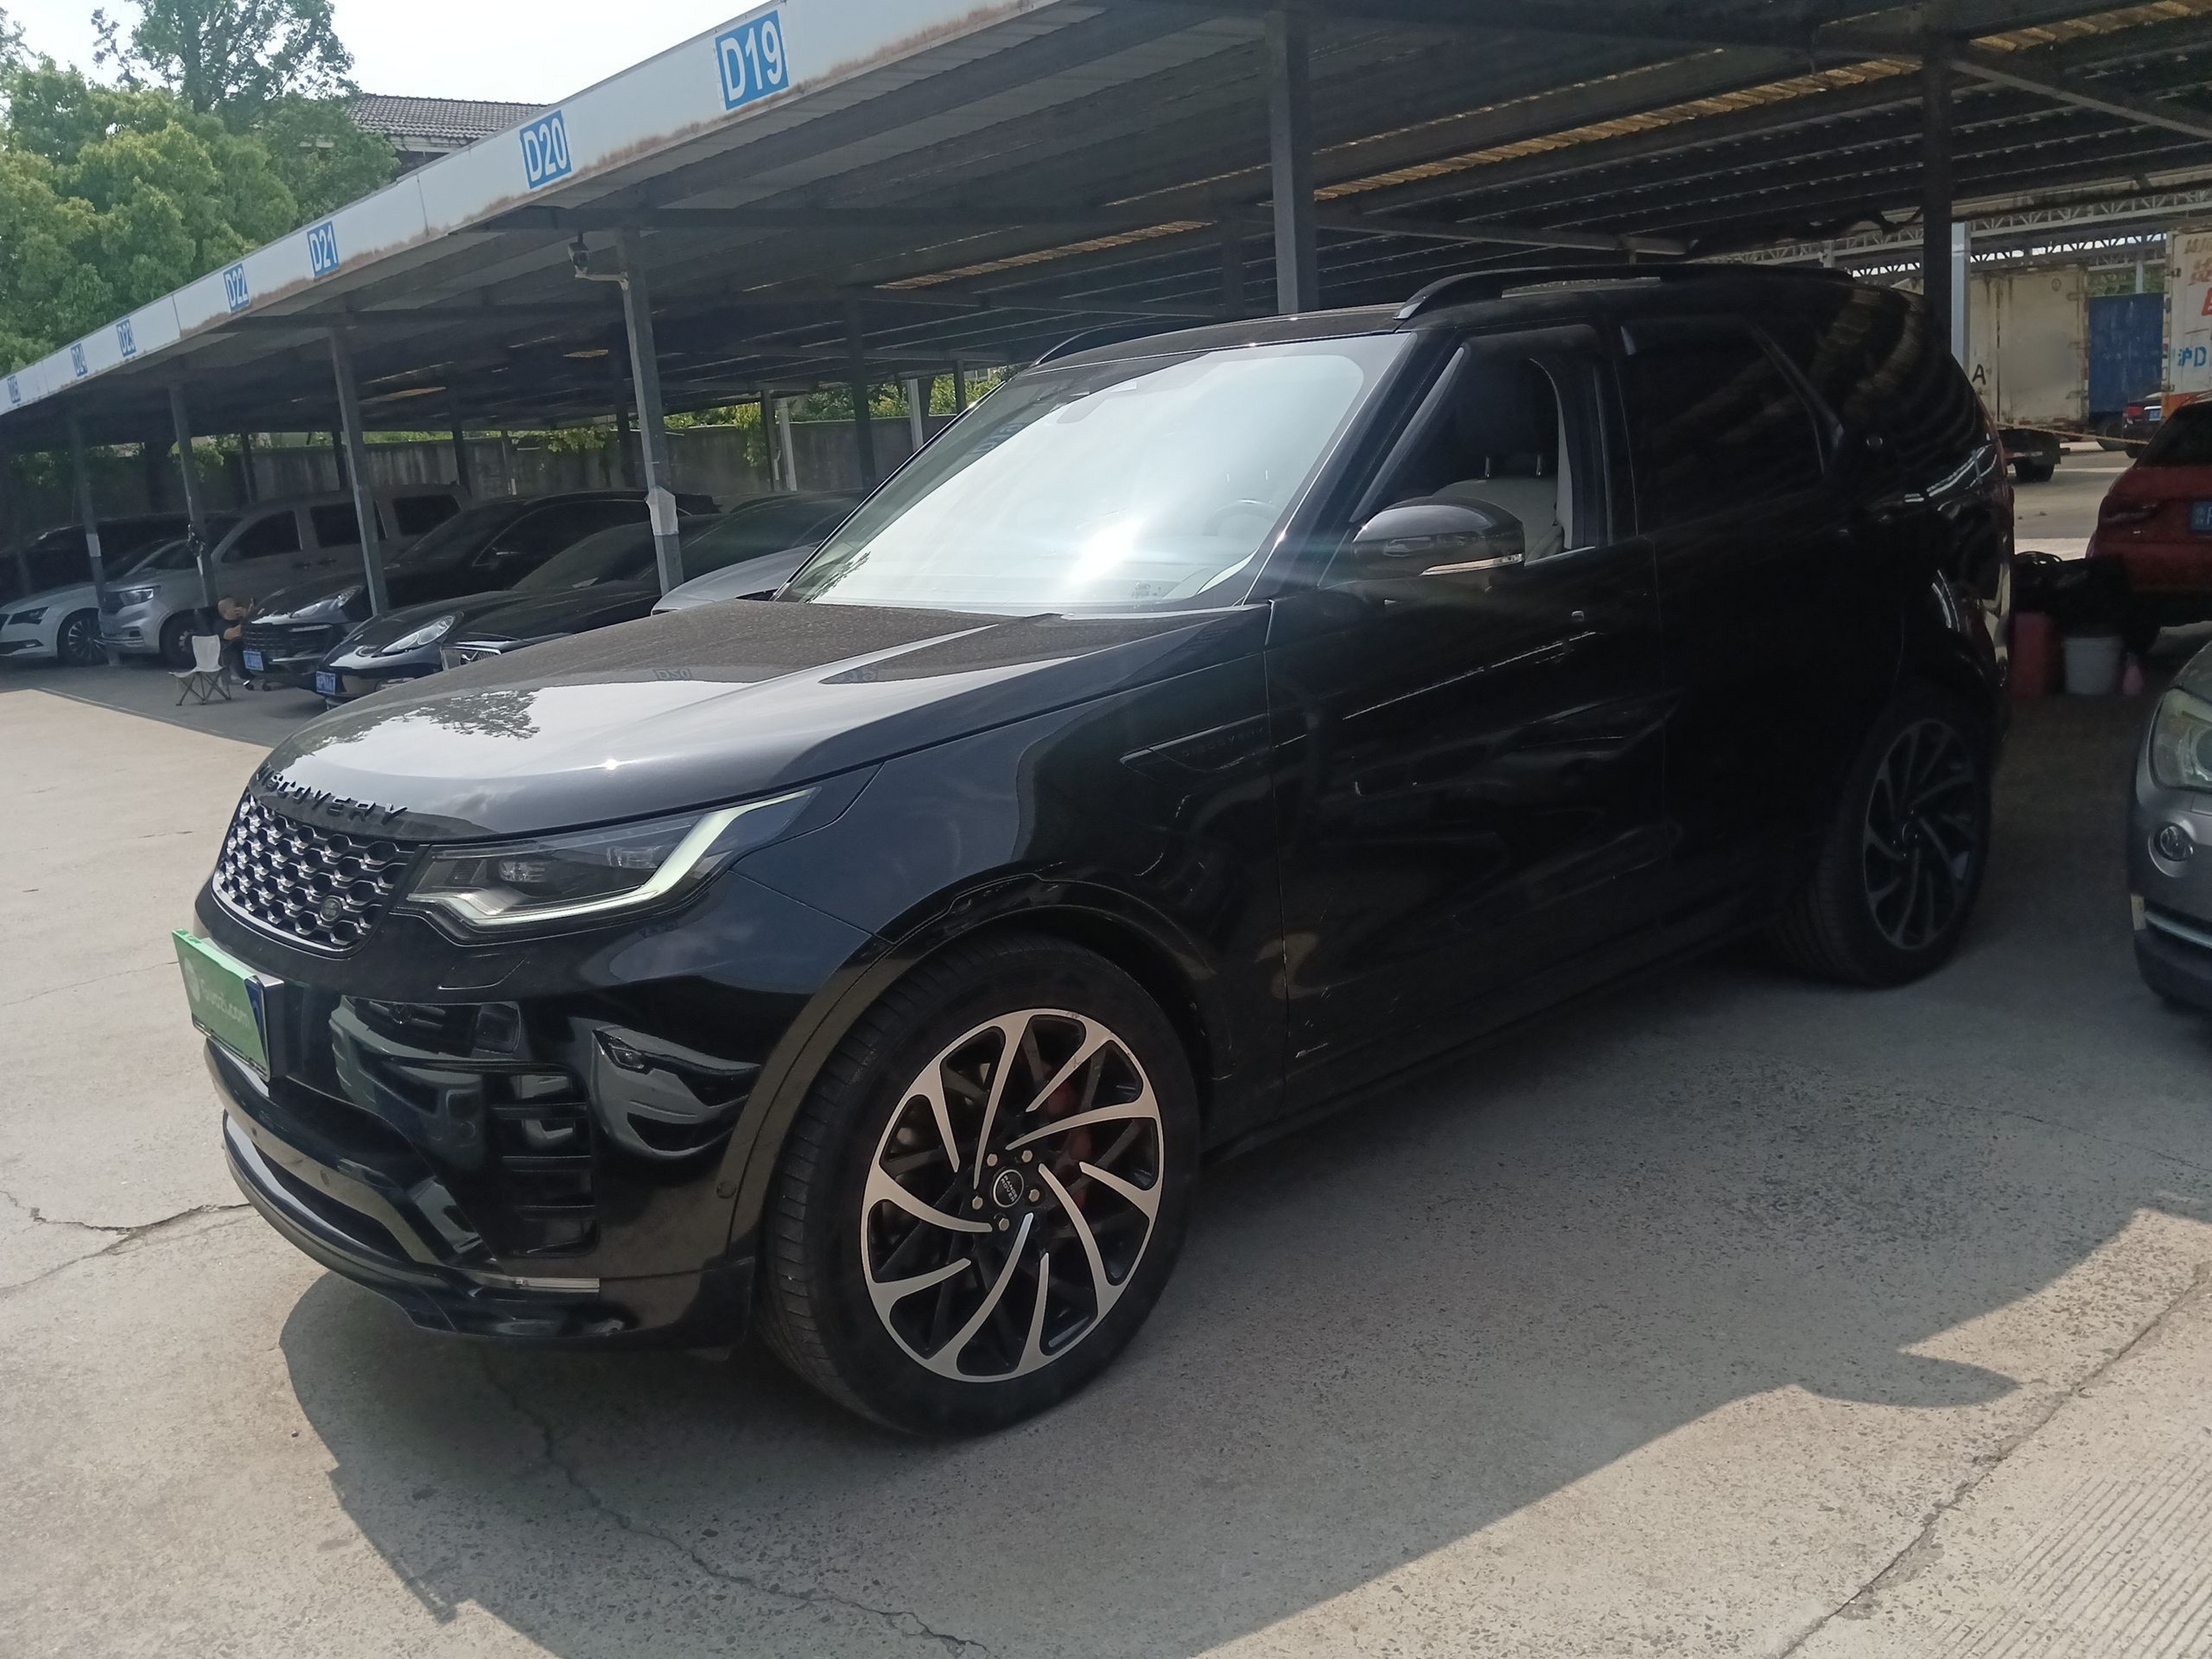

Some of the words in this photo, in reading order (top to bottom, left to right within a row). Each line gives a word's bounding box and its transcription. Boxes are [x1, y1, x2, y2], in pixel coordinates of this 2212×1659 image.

[720, 20, 783, 102] D19
[523, 116, 568, 182] D20
[310, 225, 338, 273] D21
[226, 268, 248, 309] D22
[118, 321, 137, 355] D23
[1001, 1178, 1015, 1202] ROVER
